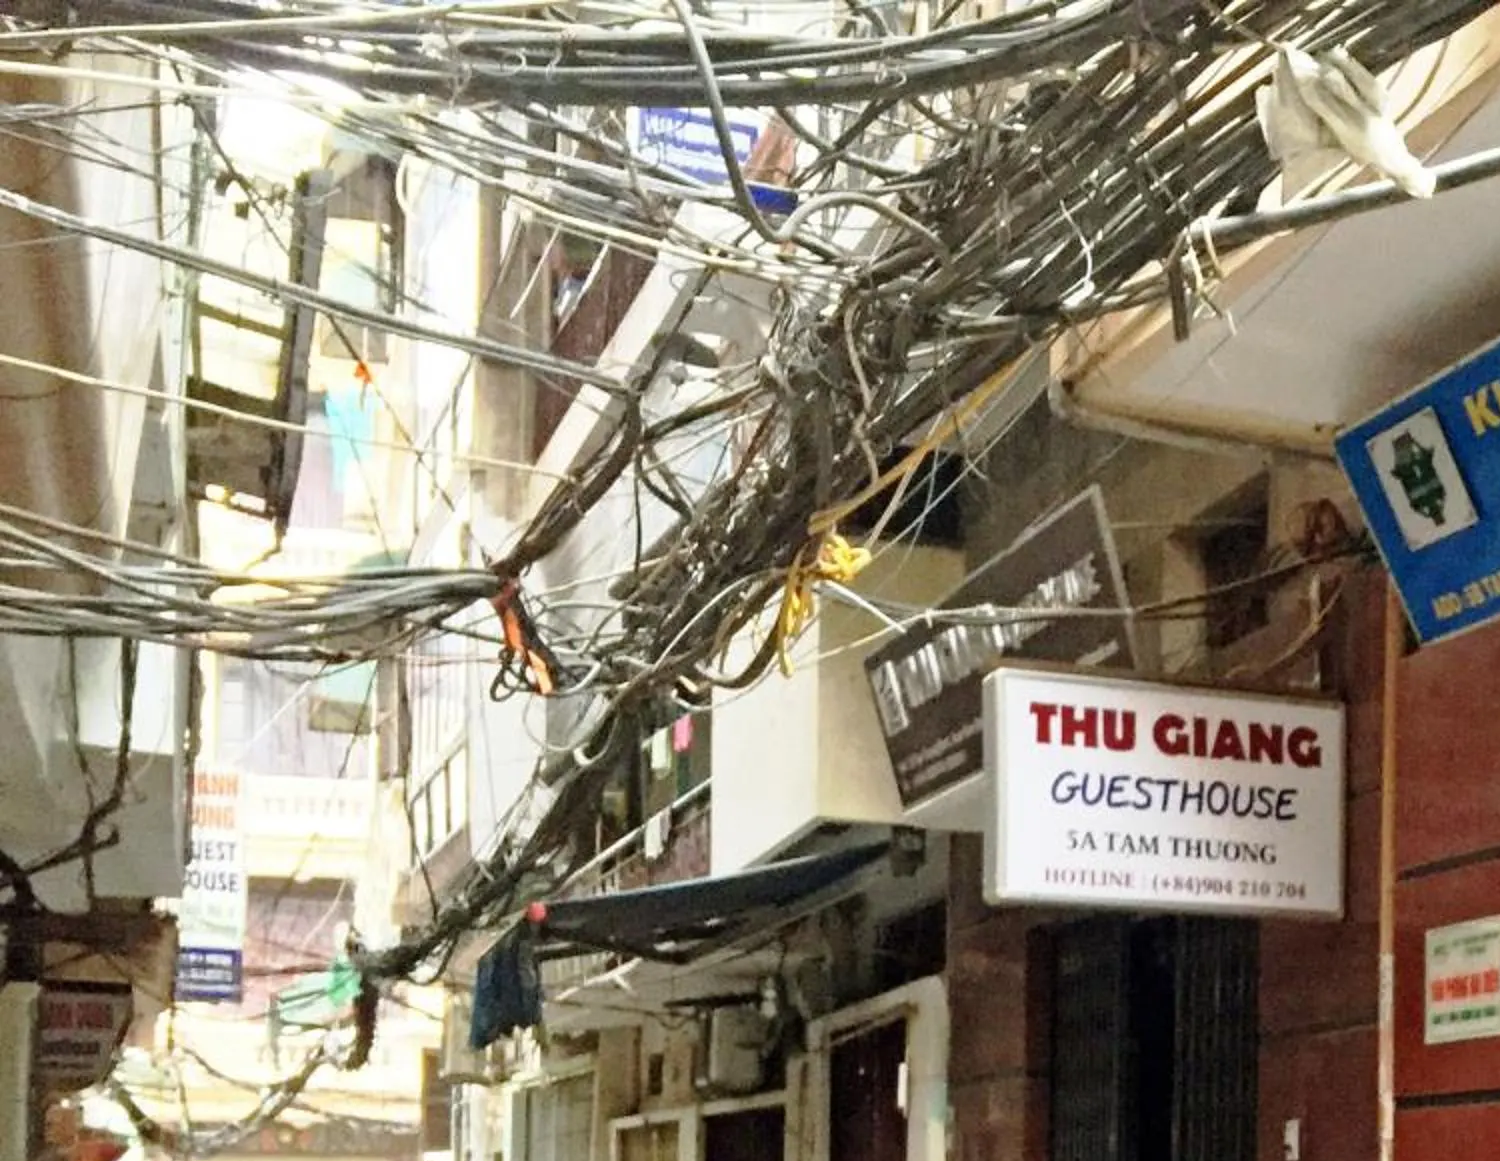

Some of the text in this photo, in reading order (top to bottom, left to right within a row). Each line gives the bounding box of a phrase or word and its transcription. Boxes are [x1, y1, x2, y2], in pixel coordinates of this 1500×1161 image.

[1029, 701, 1323, 769] THU GIANG
[1051, 770, 1298, 821] GUESTHOUSE
[1067, 830, 1097, 850] 5A
[183, 870, 240, 892] OUSE
